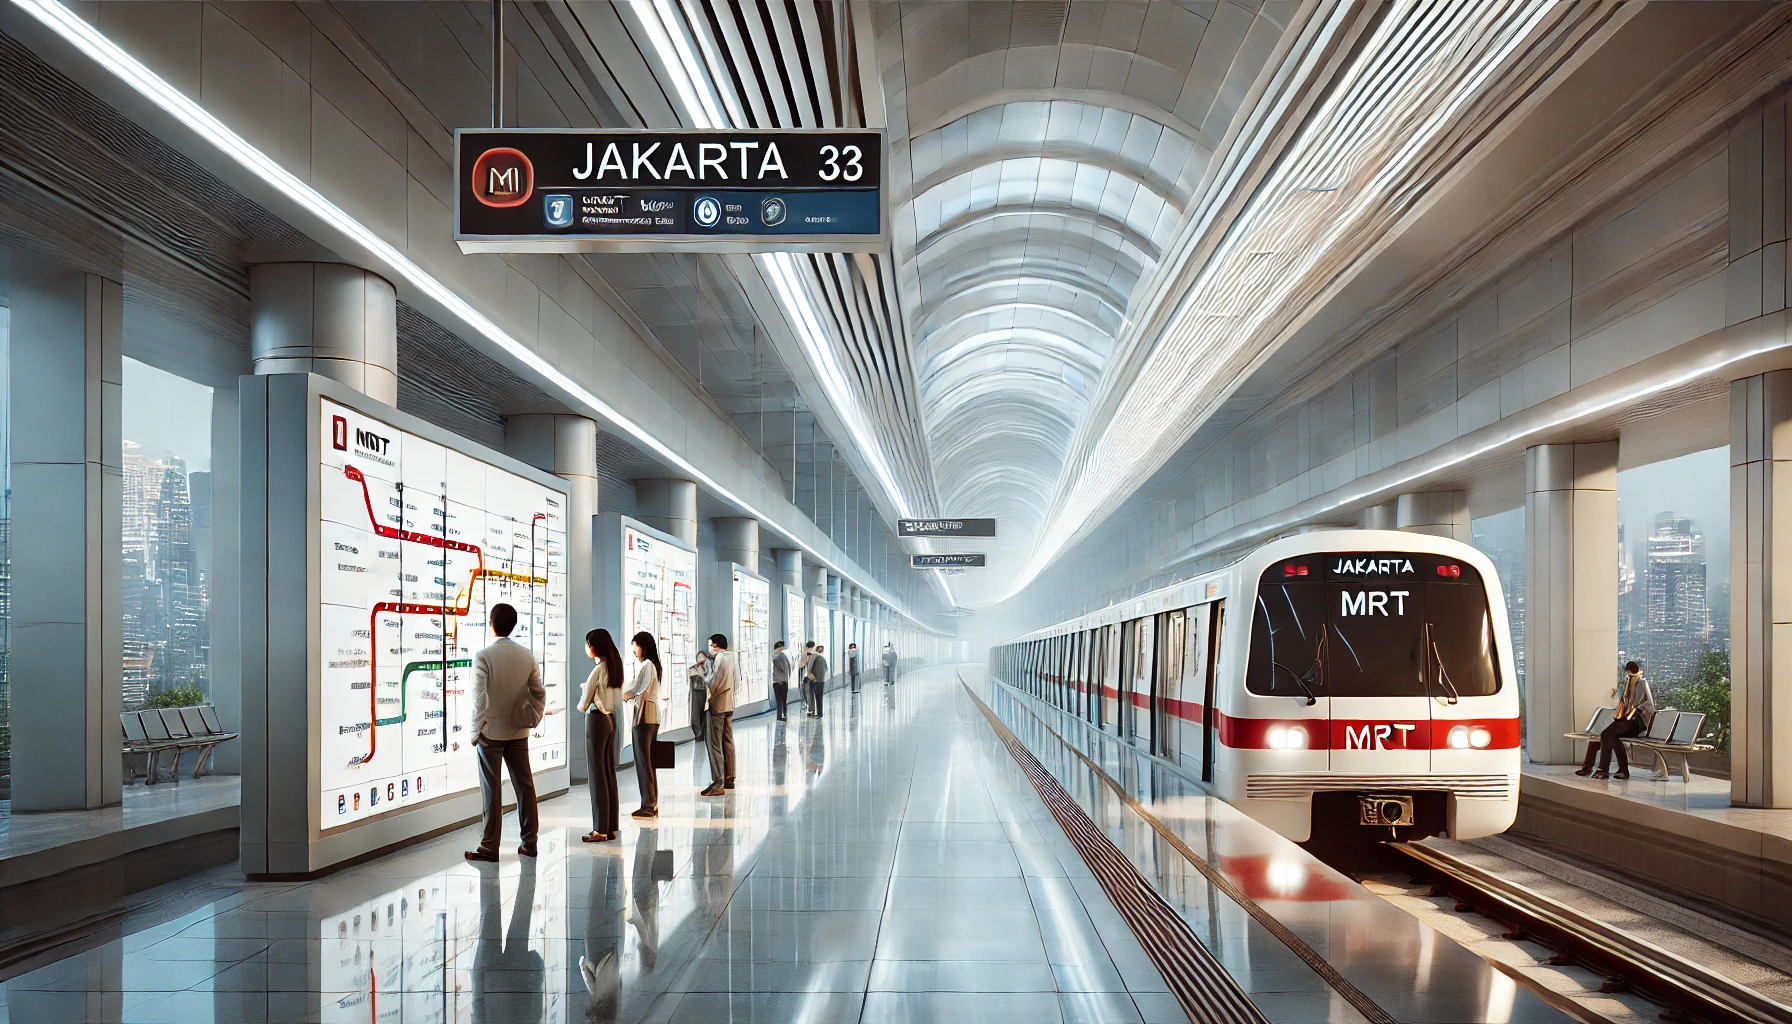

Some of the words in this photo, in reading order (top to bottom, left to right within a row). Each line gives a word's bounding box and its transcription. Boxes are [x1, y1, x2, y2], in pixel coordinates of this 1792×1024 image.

[572, 141, 789, 180] JAKARTA
[818, 144, 864, 182] 33
[1332, 557, 1415, 576] JAKARTA
[1340, 590, 1410, 617] MRT
[1345, 723, 1416, 751] MRT
